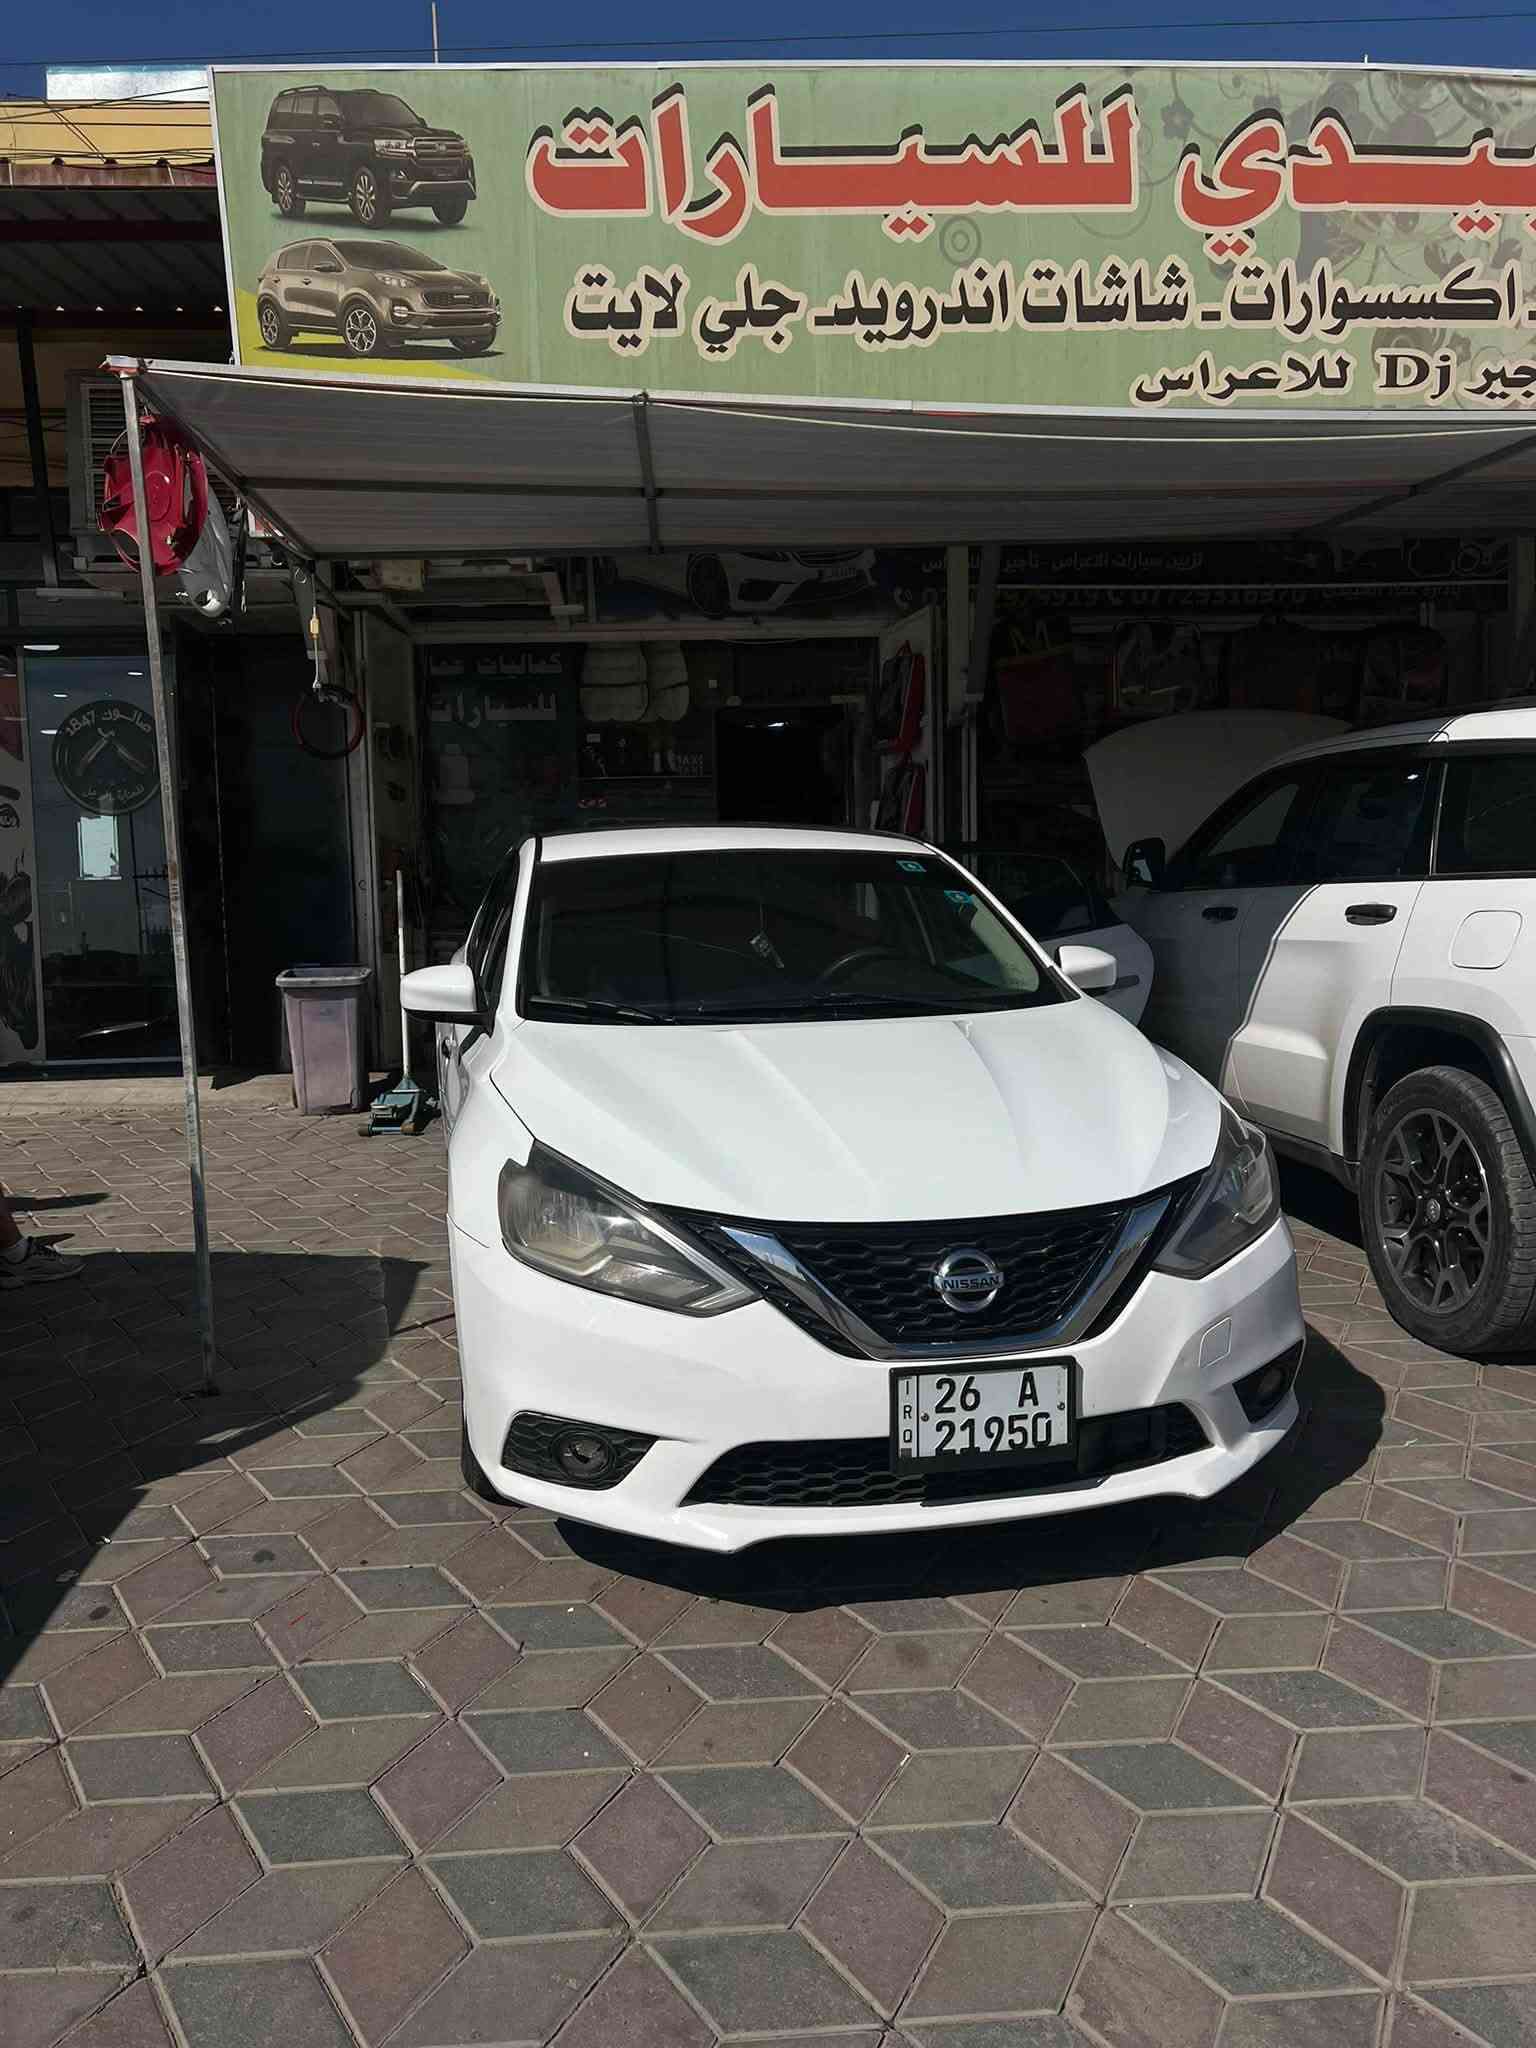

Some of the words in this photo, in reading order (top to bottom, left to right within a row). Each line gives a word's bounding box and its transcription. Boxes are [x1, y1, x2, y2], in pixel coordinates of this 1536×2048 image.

[527, 82, 1137, 245] للسيارات
[1177, 108, 1536, 258] يدي
[570, 270, 683, 348] لايت
[698, 271, 801, 354] جلي
[1022, 263, 1192, 322] شاشات
[1229, 264, 1516, 336] اكسسوارات
[1134, 356, 1350, 401] للاعراس
[1379, 354, 1450, 399] Dj
[942, 1275, 1001, 1290] NISSAN
[934, 1375, 981, 1414] 26
[1017, 1371, 1039, 1408] A
[934, 1411, 1052, 1454] 21950
